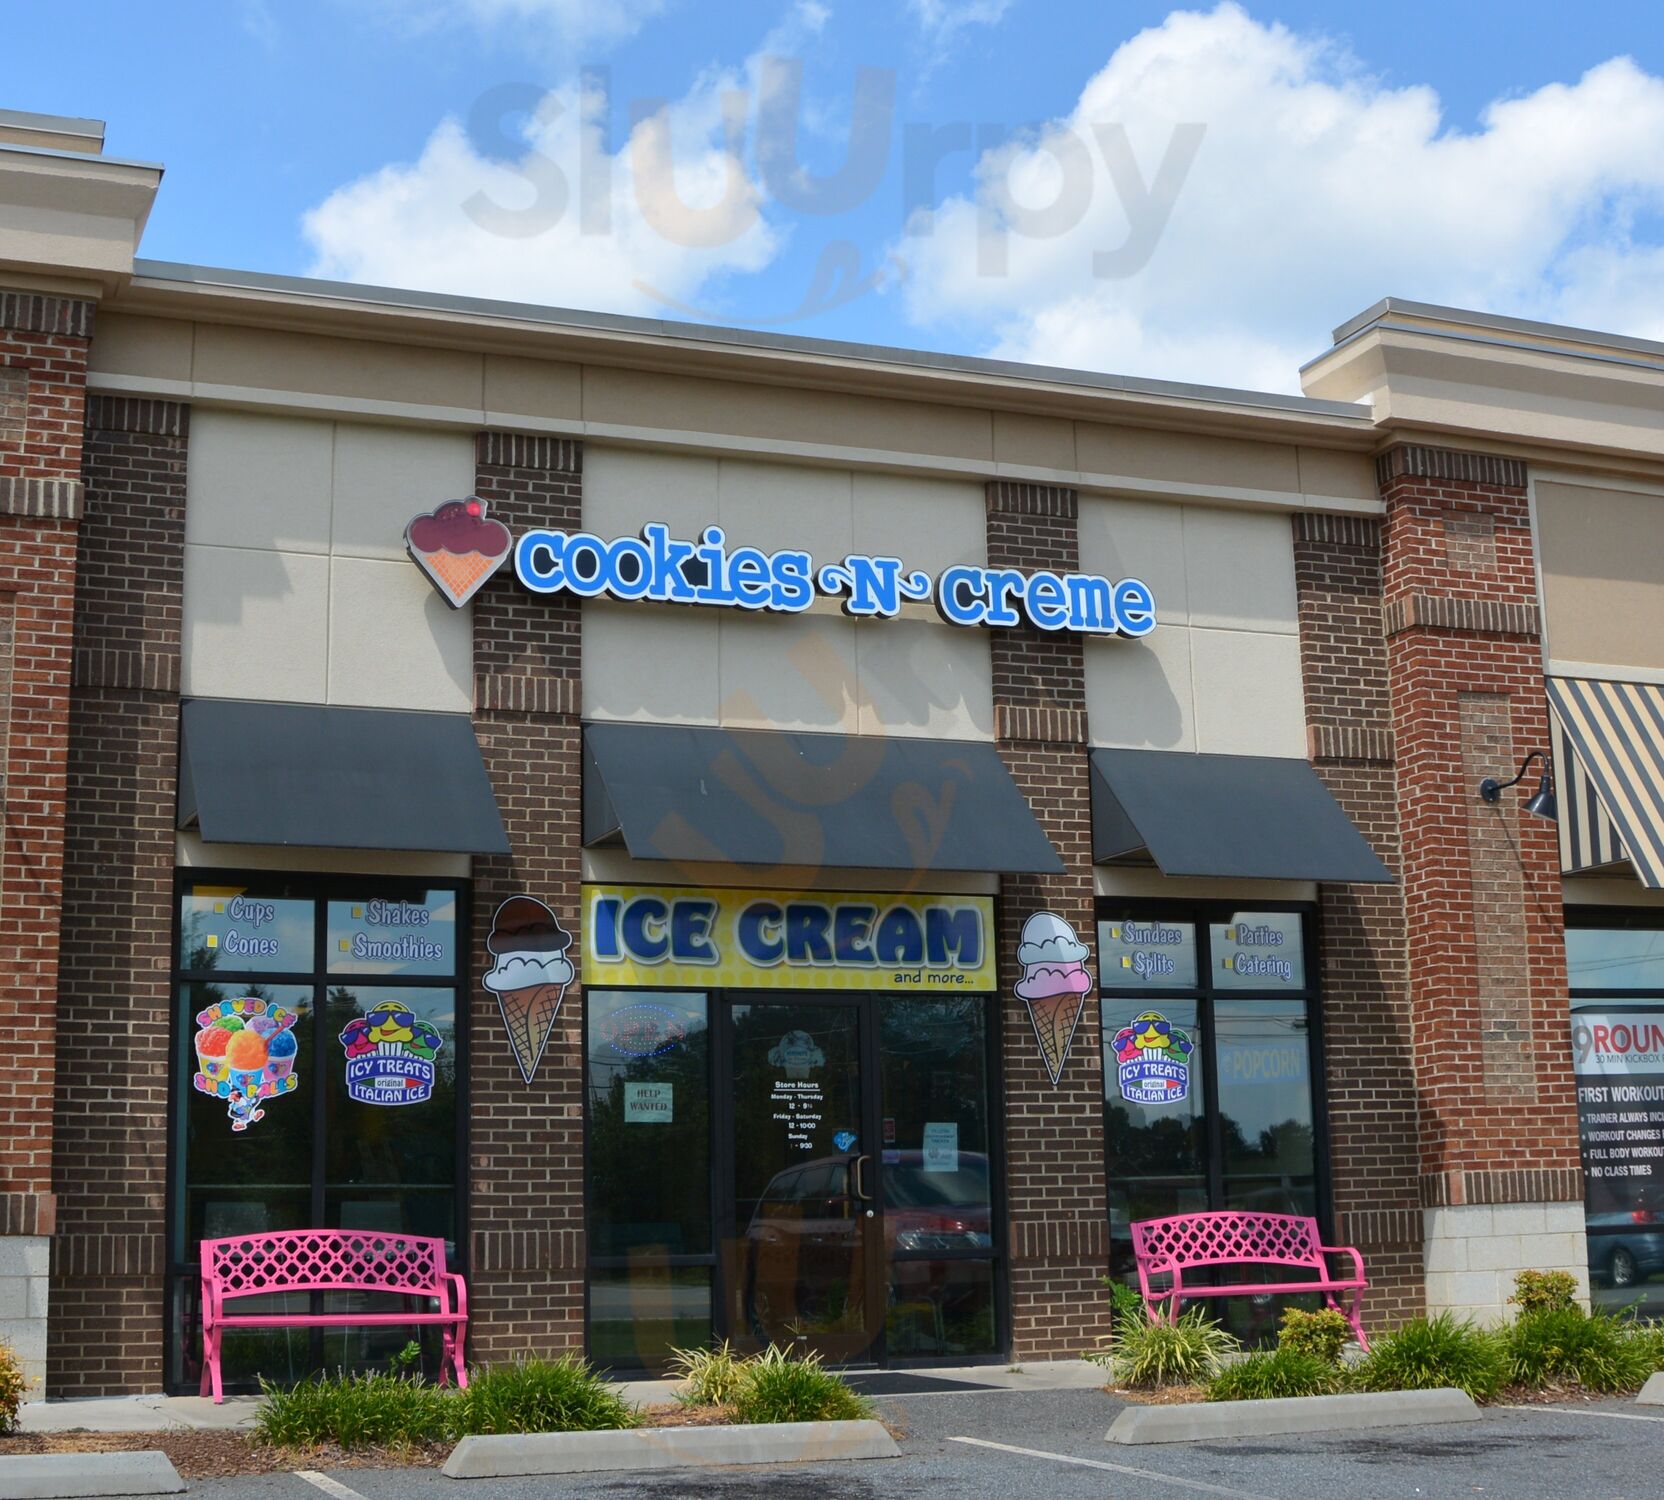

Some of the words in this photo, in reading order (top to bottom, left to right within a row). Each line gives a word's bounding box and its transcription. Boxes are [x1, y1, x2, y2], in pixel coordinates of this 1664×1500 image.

[516, 524, 813, 611] cookies
[939, 565, 1157, 635] creme
[228, 895, 275, 927] Cups
[367, 899, 430, 925] Shakes
[591, 895, 718, 964] ICE
[736, 901, 983, 969] CREAM
[1124, 921, 1182, 944] Sundaes
[1238, 924, 1284, 945] Parties
[224, 930, 279, 956] Cones
[353, 932, 443, 958] Smoothies
[1135, 951, 1175, 980] Splits
[1236, 952, 1291, 980] Catering
[894, 969, 921, 983] and
[928, 974, 974, 984] more...
[197, 998, 266, 1028] SHAVED
[267, 1003, 297, 1028] ICE
[599, 1021, 685, 1041] OPEN
[1233, 1049, 1300, 1079] POPCORN
[1595, 1054, 1605, 1064] 30
[1607, 1054, 1623, 1064] MIN
[1625, 1054, 1660, 1064] KICKBOX
[350, 1061, 373, 1078] ICY
[377, 1060, 431, 1079] TREATS
[1122, 1065, 1140, 1081] ICY
[1143, 1063, 1186, 1080] TREATS
[195, 1073, 231, 1098] SNO
[247, 1074, 297, 1099] BALLS
[355, 1084, 402, 1102] ITALIAN
[406, 1086, 425, 1100] ICE
[377, 1080, 404, 1088] original
[775, 1081, 796, 1089] Store
[798, 1081, 819, 1089] Hours
[1126, 1086, 1164, 1101] ITALIAN
[1167, 1087, 1183, 1099] ICE
[637, 1090, 661, 1098] HELP
[1578, 1086, 1609, 1103] FIRST
[1611, 1085, 1664, 1102] WORKOUT
[630, 1102, 667, 1111] WANTED
[1586, 1113, 1618, 1123] TRAINER
[1619, 1111, 1648, 1123] ALWAYS
[1588, 1130, 1625, 1141] WORKOUT
[1626, 1129, 1661, 1140] CHANGES
[1590, 1148, 1608, 1159] FULL
[1609, 1147, 1631, 1158] BODY
[1591, 1166, 1603, 1178] NO
[1604, 1165, 1629, 1177] CLASS
[1629, 1164, 1653, 1176] TIMES
